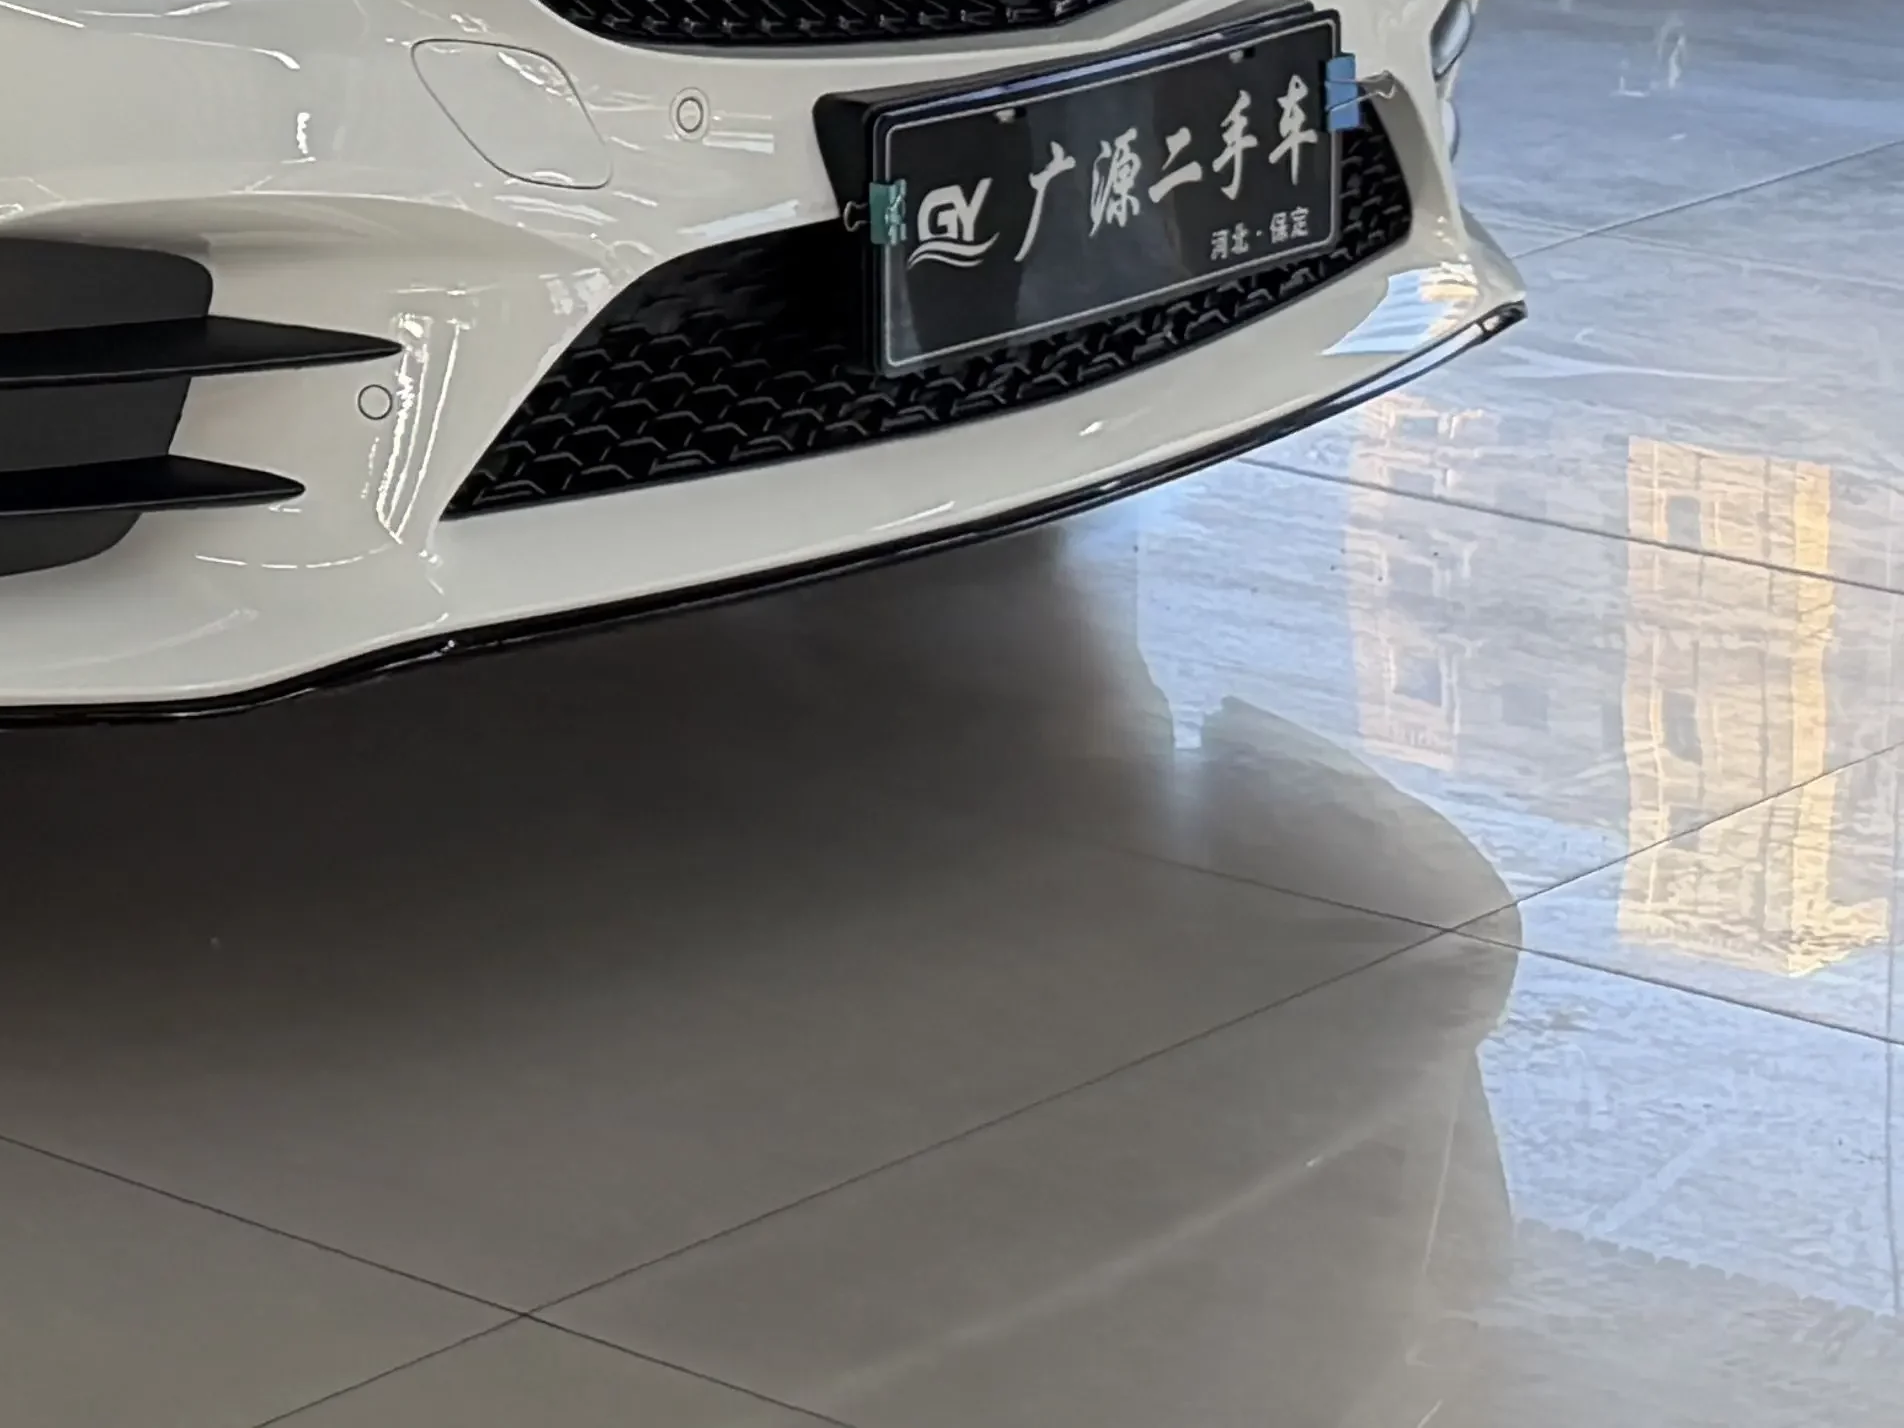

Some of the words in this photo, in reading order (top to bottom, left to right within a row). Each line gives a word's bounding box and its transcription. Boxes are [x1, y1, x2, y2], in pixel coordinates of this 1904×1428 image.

[1014, 74, 1319, 262] 广源二手车
